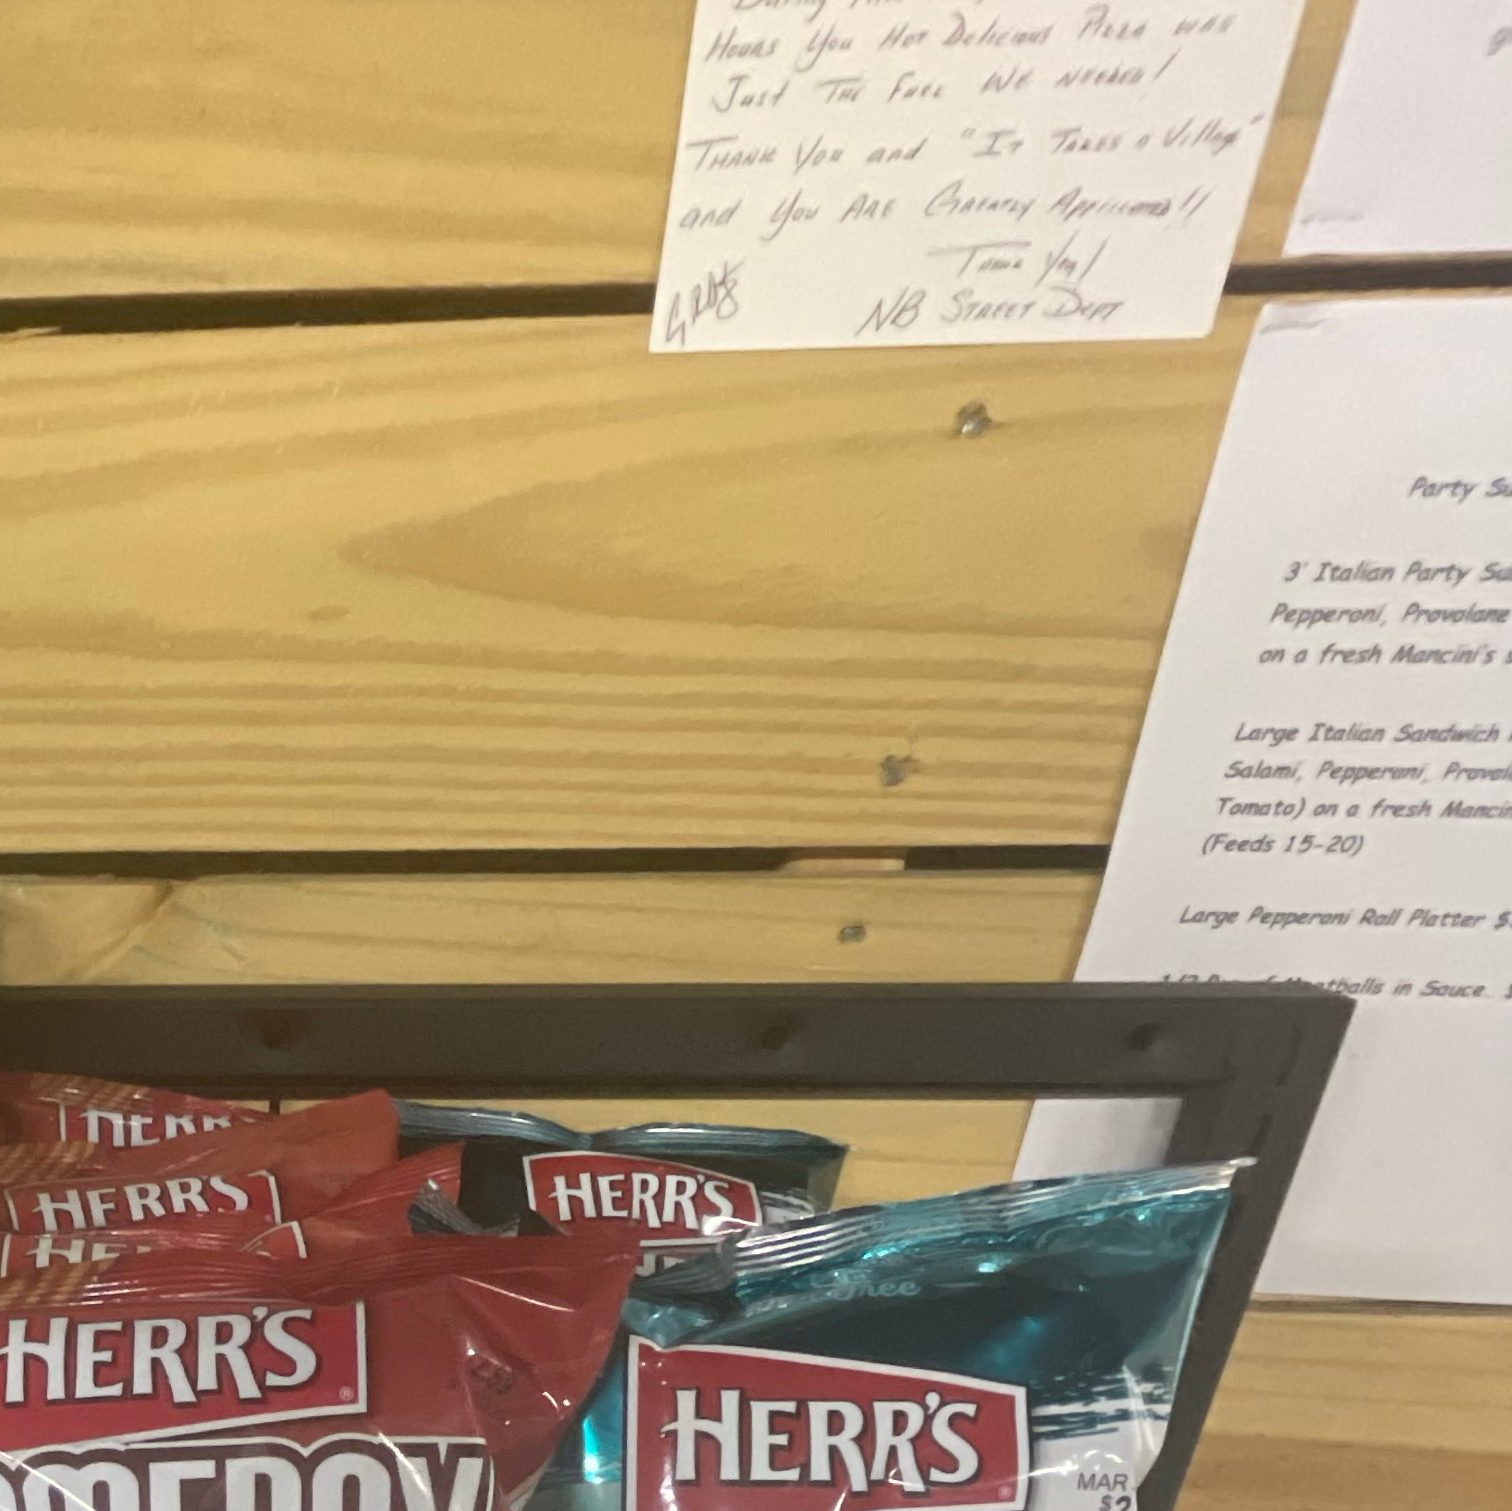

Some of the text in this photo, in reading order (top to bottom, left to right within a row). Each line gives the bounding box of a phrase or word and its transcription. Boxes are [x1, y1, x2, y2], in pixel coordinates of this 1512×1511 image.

[865, 136, 932, 164] and
[679, 198, 743, 229] and
[1409, 475, 1479, 505] Party
[1313, 560, 1396, 583] Italian
[1403, 560, 1473, 588] Party
[1259, 649, 1285, 665] on
[1293, 649, 1308, 665] a
[1319, 643, 1384, 666] fresh
[1234, 721, 1299, 747] Large
[1307, 721, 1386, 743] Italian
[1393, 722, 1500, 743] Sandwich
[1217, 796, 1306, 822] Tomato)
[1313, 803, 1339, 818] on
[1346, 803, 1360, 818] a
[1370, 798, 1433, 819] fresh
[1202, 833, 1365, 857] (Feeds 15-20)
[1179, 905, 1240, 929] Large
[1247, 906, 1351, 930] Pepperoni
[1406, 909, 1487, 928] Platter
[1392, 979, 1413, 996] in
[1420, 980, 1486, 998] Sauce
[548, 1171, 735, 1237] HERR'S
[659, 1387, 979, 1494] HERR'S
